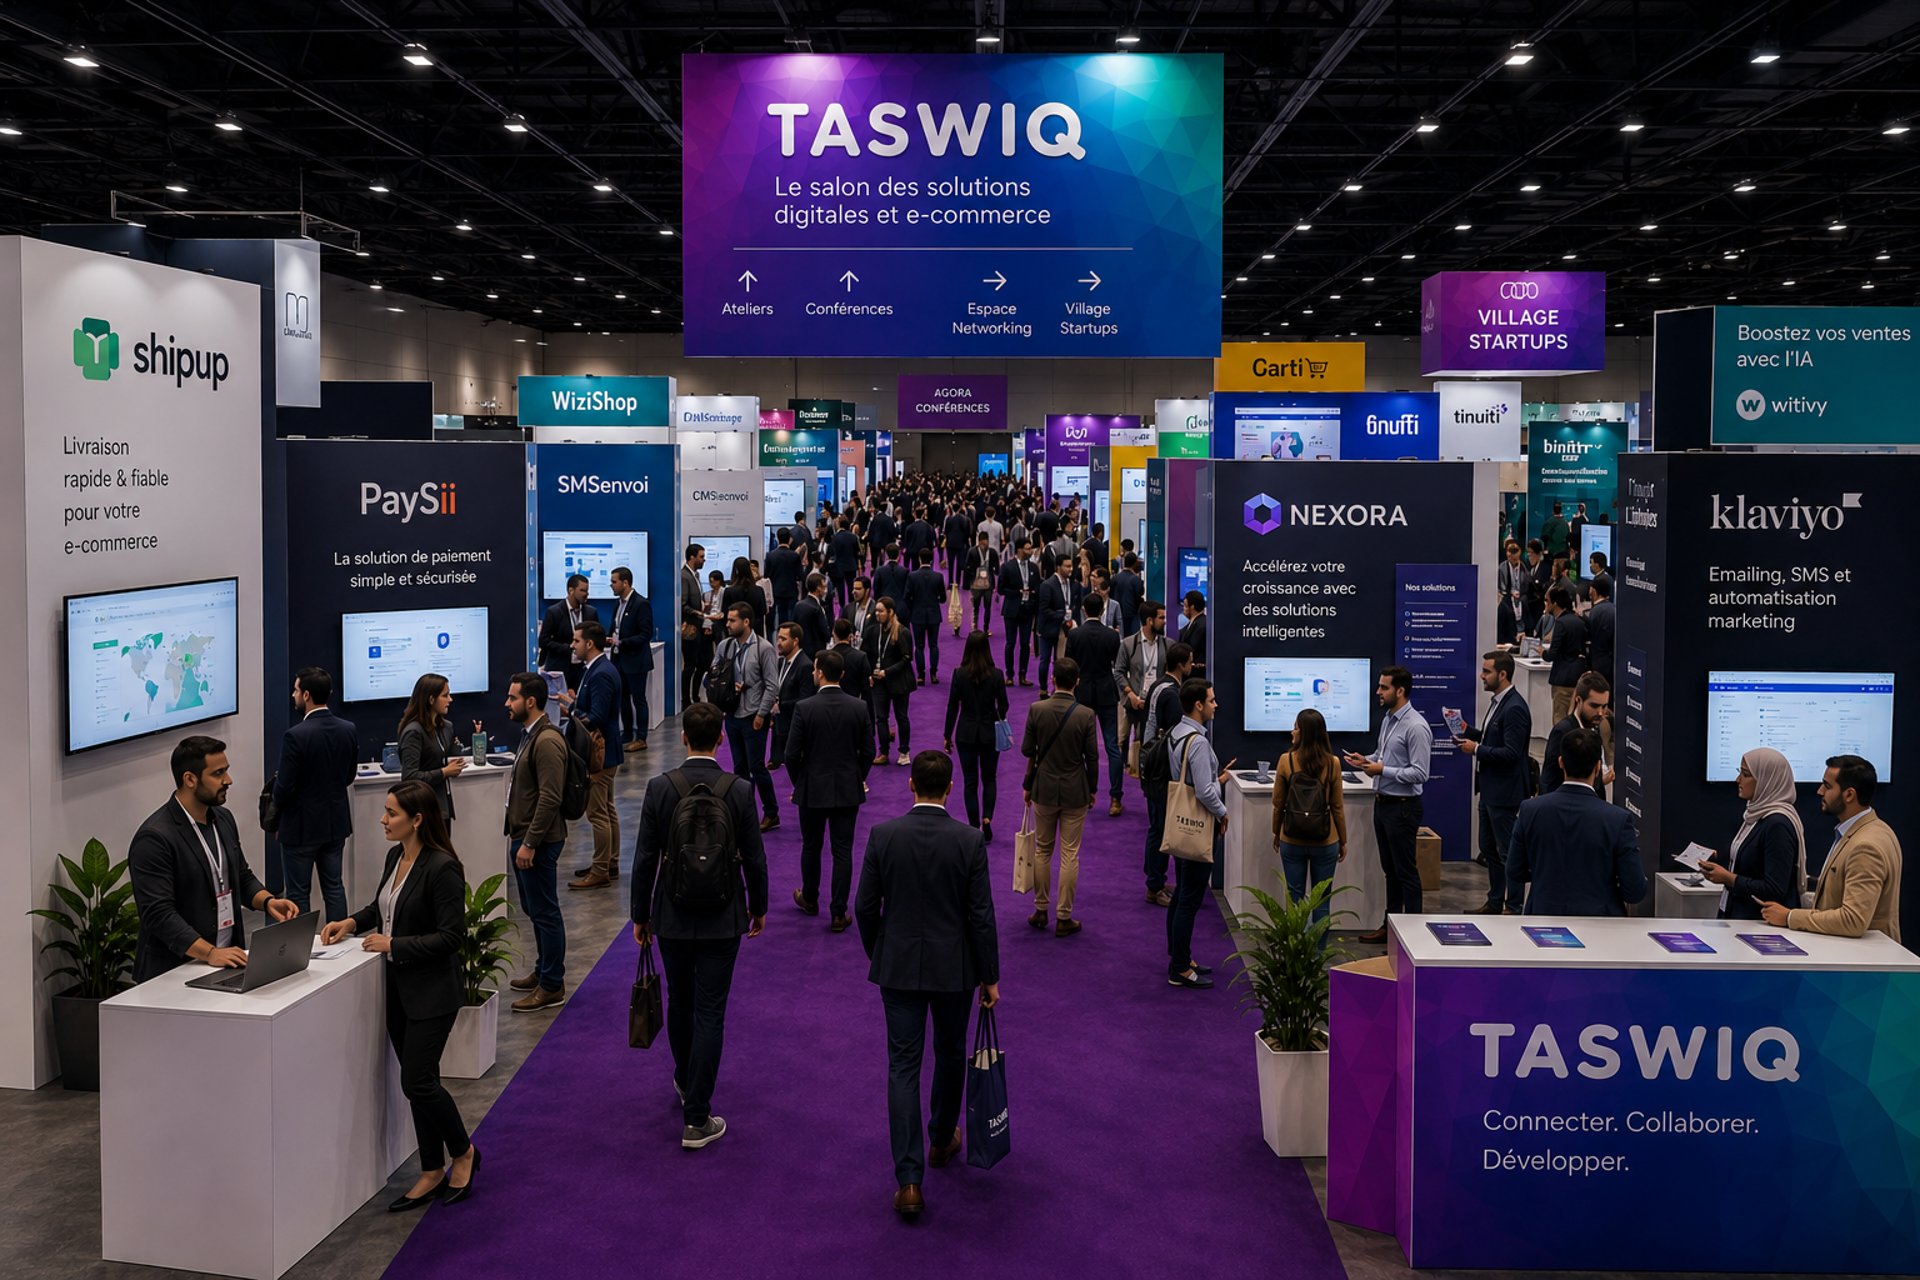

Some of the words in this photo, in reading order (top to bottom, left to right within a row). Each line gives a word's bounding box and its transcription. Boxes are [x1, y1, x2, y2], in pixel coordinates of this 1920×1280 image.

[767, 103, 1086, 161] TASWIQ
[776, 177, 801, 196] Le
[811, 176, 870, 196] salon
[879, 176, 918, 196] des
[928, 176, 1030, 196] solutions
[775, 204, 868, 229] digitales
[877, 207, 898, 224] et
[907, 210, 1050, 224] e-commerce
[722, 303, 773, 315] Ateliers
[806, 302, 893, 315] Conférences
[967, 304, 1017, 319] Espace
[1065, 303, 1111, 319] Village
[1478, 310, 1558, 325] VILLAGE
[953, 322, 1031, 337] Networking
[1061, 322, 1118, 337] Startups
[1739, 325, 1810, 340] Boostez
[1816, 329, 1846, 340] vos
[1852, 327, 1910, 340] ventes
[1470, 334, 1567, 349] STARTUPS
[134, 332, 229, 391] shipup
[1253, 358, 1302, 377] Carti
[1737, 355, 1779, 367] avec
[935, 389, 971, 397] AGORA
[552, 391, 637, 416] WiziShop
[916, 402, 990, 412] CONFÉRENCES
[1772, 397, 1827, 416] witivy
[1454, 405, 1500, 424] tinuiti
[64, 436, 129, 455] Livraison
[64, 469, 112, 489] rapide
[117, 469, 126, 486] &
[131, 469, 168, 486] fiable
[559, 475, 648, 493] SMSenvoi
[361, 482, 455, 523] PaySii
[64, 506, 100, 524] pour
[104, 502, 140, 519] votre
[1291, 505, 1407, 526] NEXORA
[1709, 494, 1844, 540] klaviyo
[65, 536, 157, 554] e-commerce
[335, 552, 350, 565] La
[355, 551, 407, 564] solution
[411, 550, 428, 563] de
[432, 549, 492, 568] paiement
[1243, 560, 1307, 572] Accélérez
[1311, 562, 1345, 572] votre
[350, 573, 395, 590] simple
[399, 573, 413, 586] et
[417, 570, 476, 584] sécurisée
[1710, 566, 1785, 585] Emailing,
[1792, 567, 1829, 582] SMS
[1835, 569, 1851, 582] et
[1243, 581, 1319, 594] croissance
[1323, 585, 1355, 594] avec
[1709, 590, 1836, 605] automatisation
[1243, 603, 1268, 615] des
[1273, 603, 1336, 616] solutions
[1709, 613, 1794, 632] marketing
[1243, 625, 1325, 640] intelligentes
[1470, 1023, 1800, 1082] TASWIQ
[1484, 1110, 1617, 1131] Connecter.
[1627, 1111, 1758, 1133] Collaborer.
[1484, 1149, 1628, 1176] Développer.
